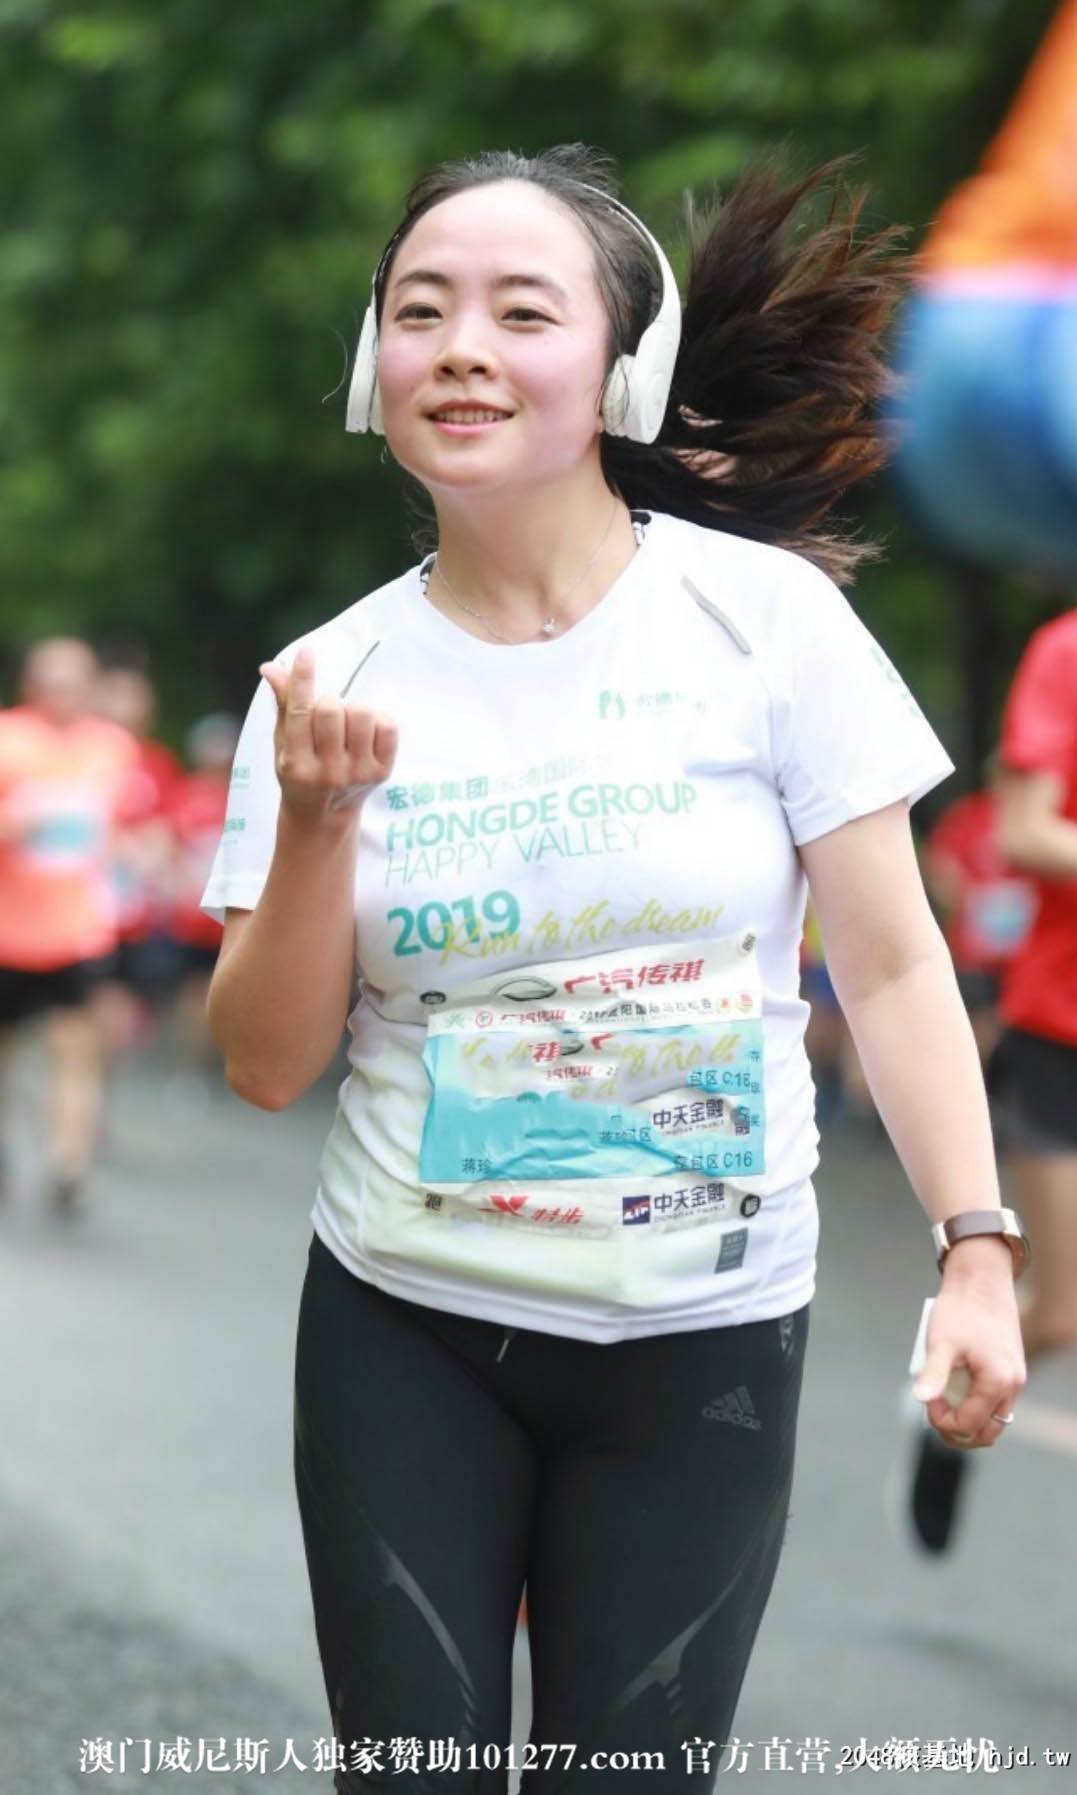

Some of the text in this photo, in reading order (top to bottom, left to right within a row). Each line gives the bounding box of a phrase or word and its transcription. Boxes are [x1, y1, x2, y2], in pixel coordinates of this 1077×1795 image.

[387, 780, 699, 853] HONGDE GROUP
[385, 818, 644, 889] HAPPY VALLEY
[387, 889, 521, 958] 2019
[722, 1151, 753, 1170] C16
[654, 1182, 725, 1213] 中天金融
[702, 1407, 761, 1430] adidas
